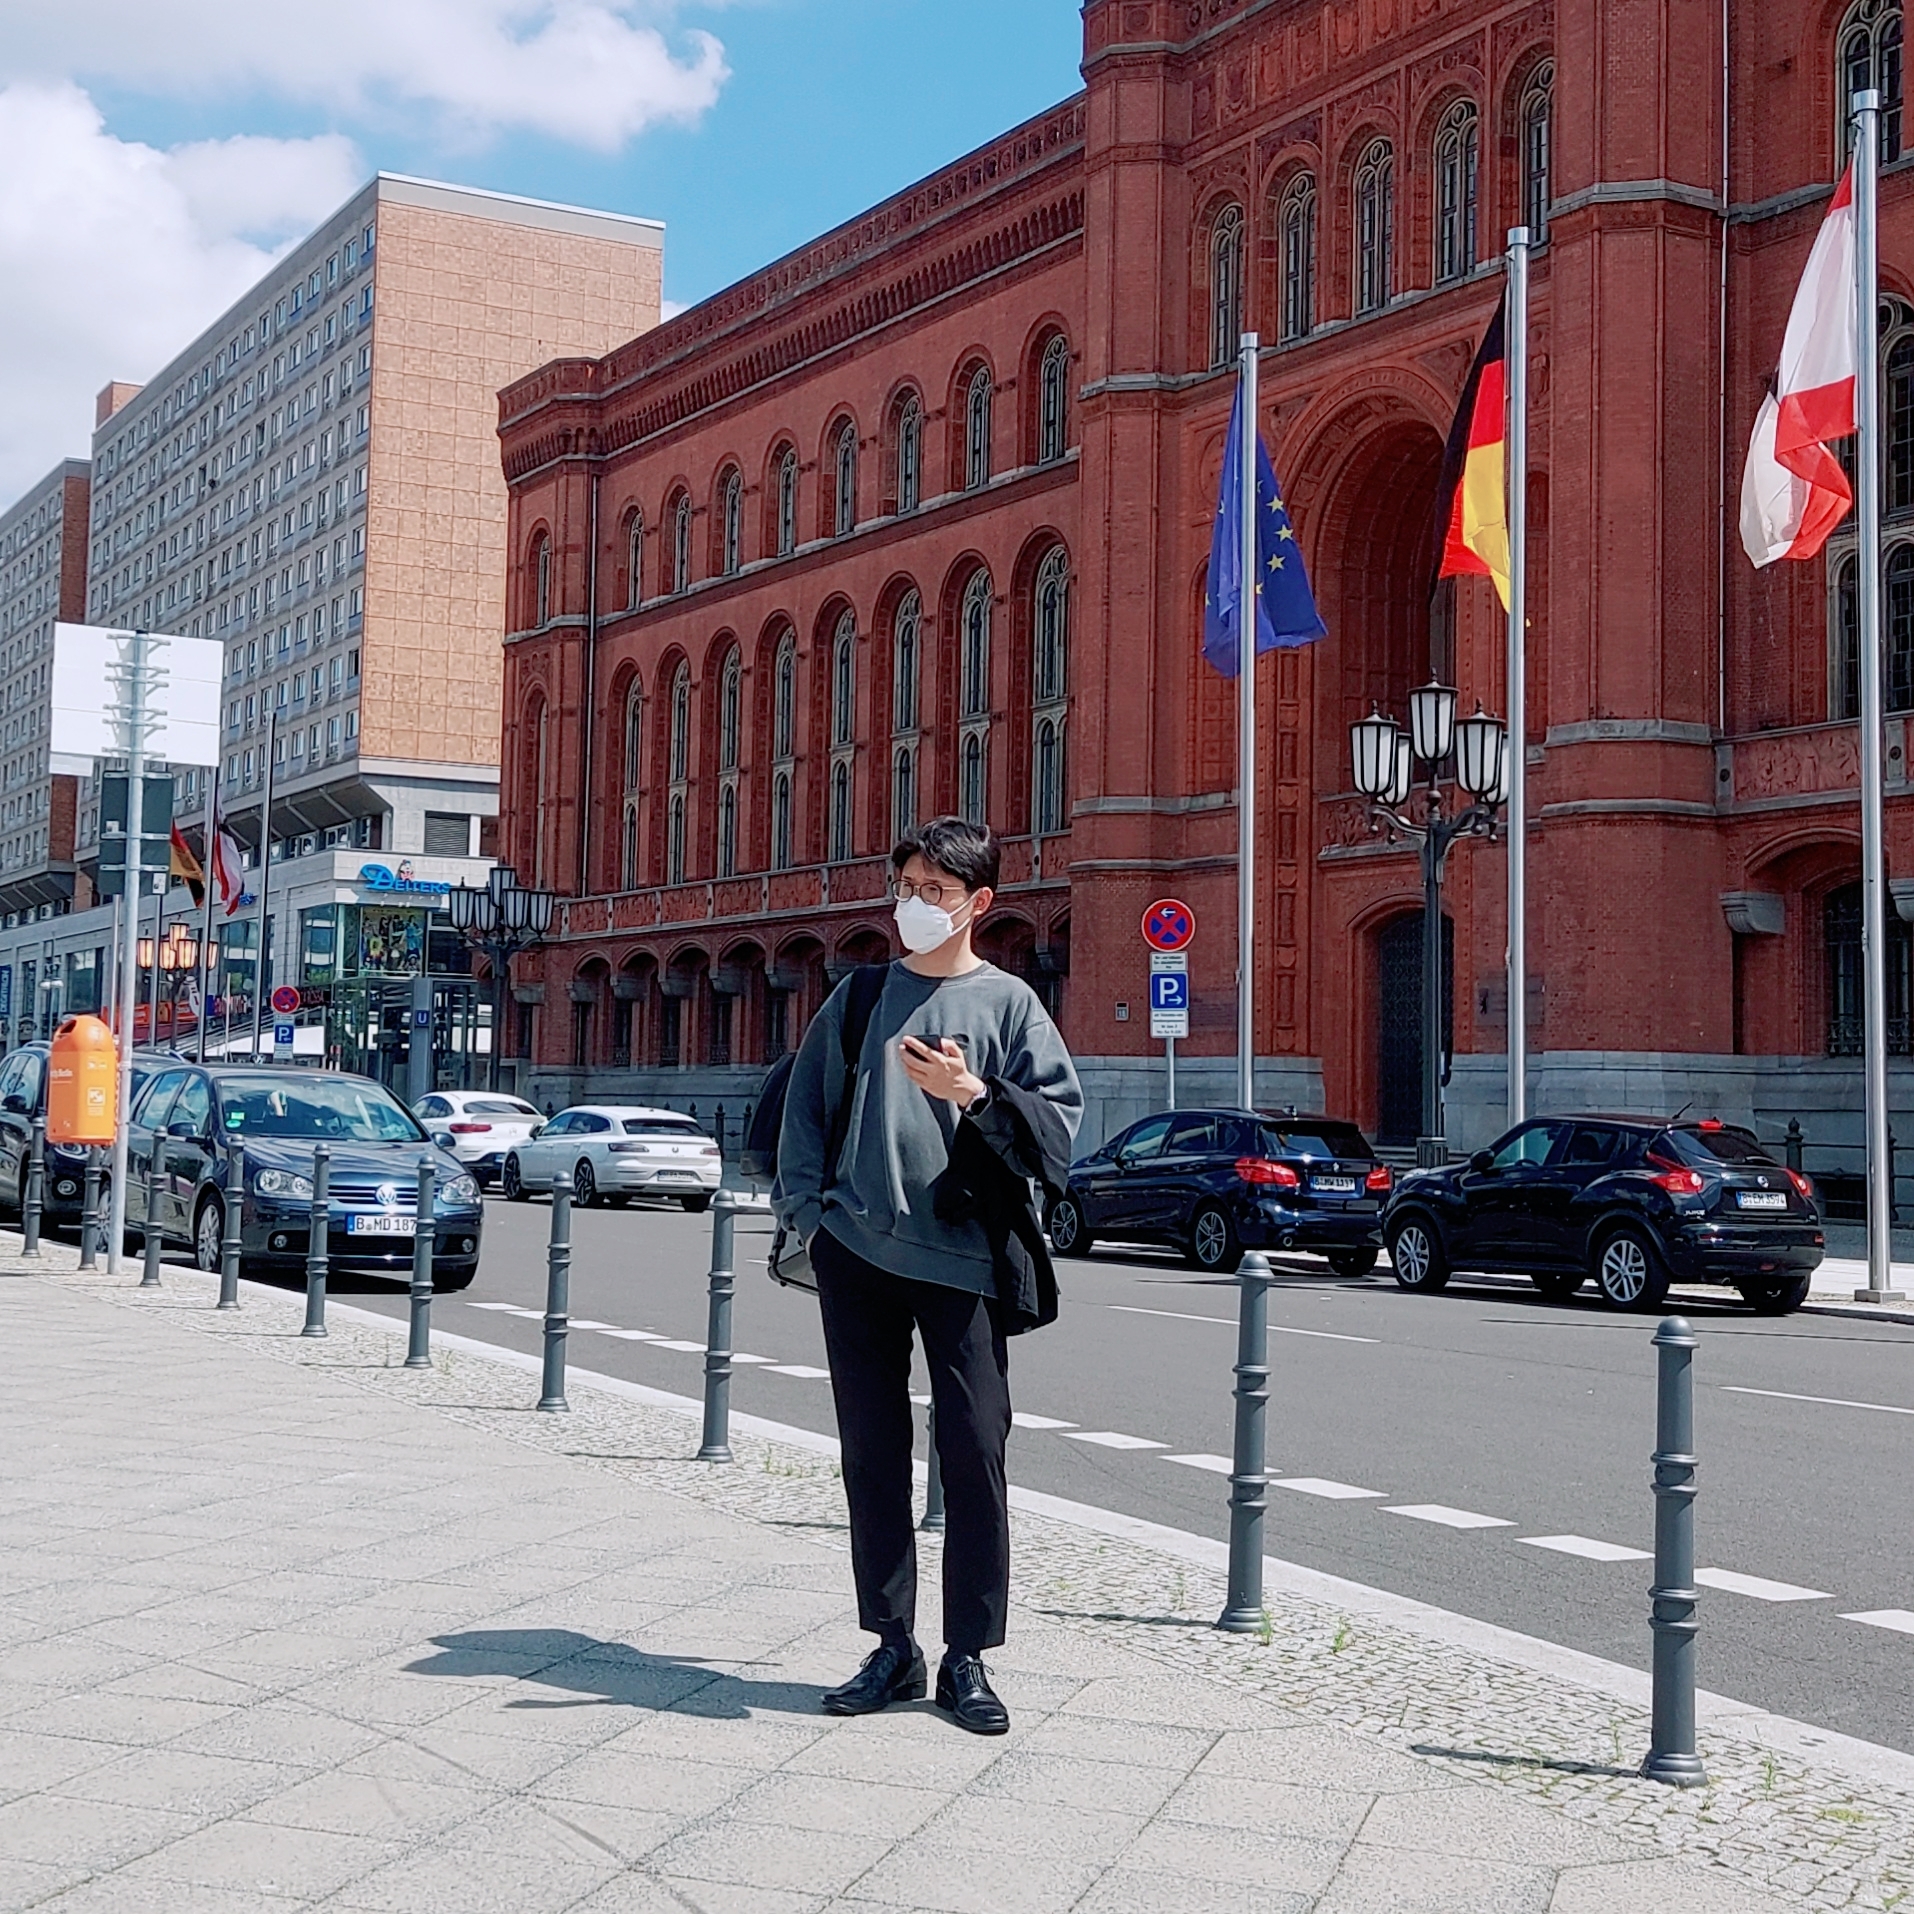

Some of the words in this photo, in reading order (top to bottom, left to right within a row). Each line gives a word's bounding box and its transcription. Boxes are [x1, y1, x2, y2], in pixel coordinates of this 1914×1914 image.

[1159, 977, 1179, 1005] P
[418, 1012, 427, 1024] U
[278, 1026, 290, 1042] P
[356, 1217, 365, 1230] B
[374, 1218, 391, 1231] MD
